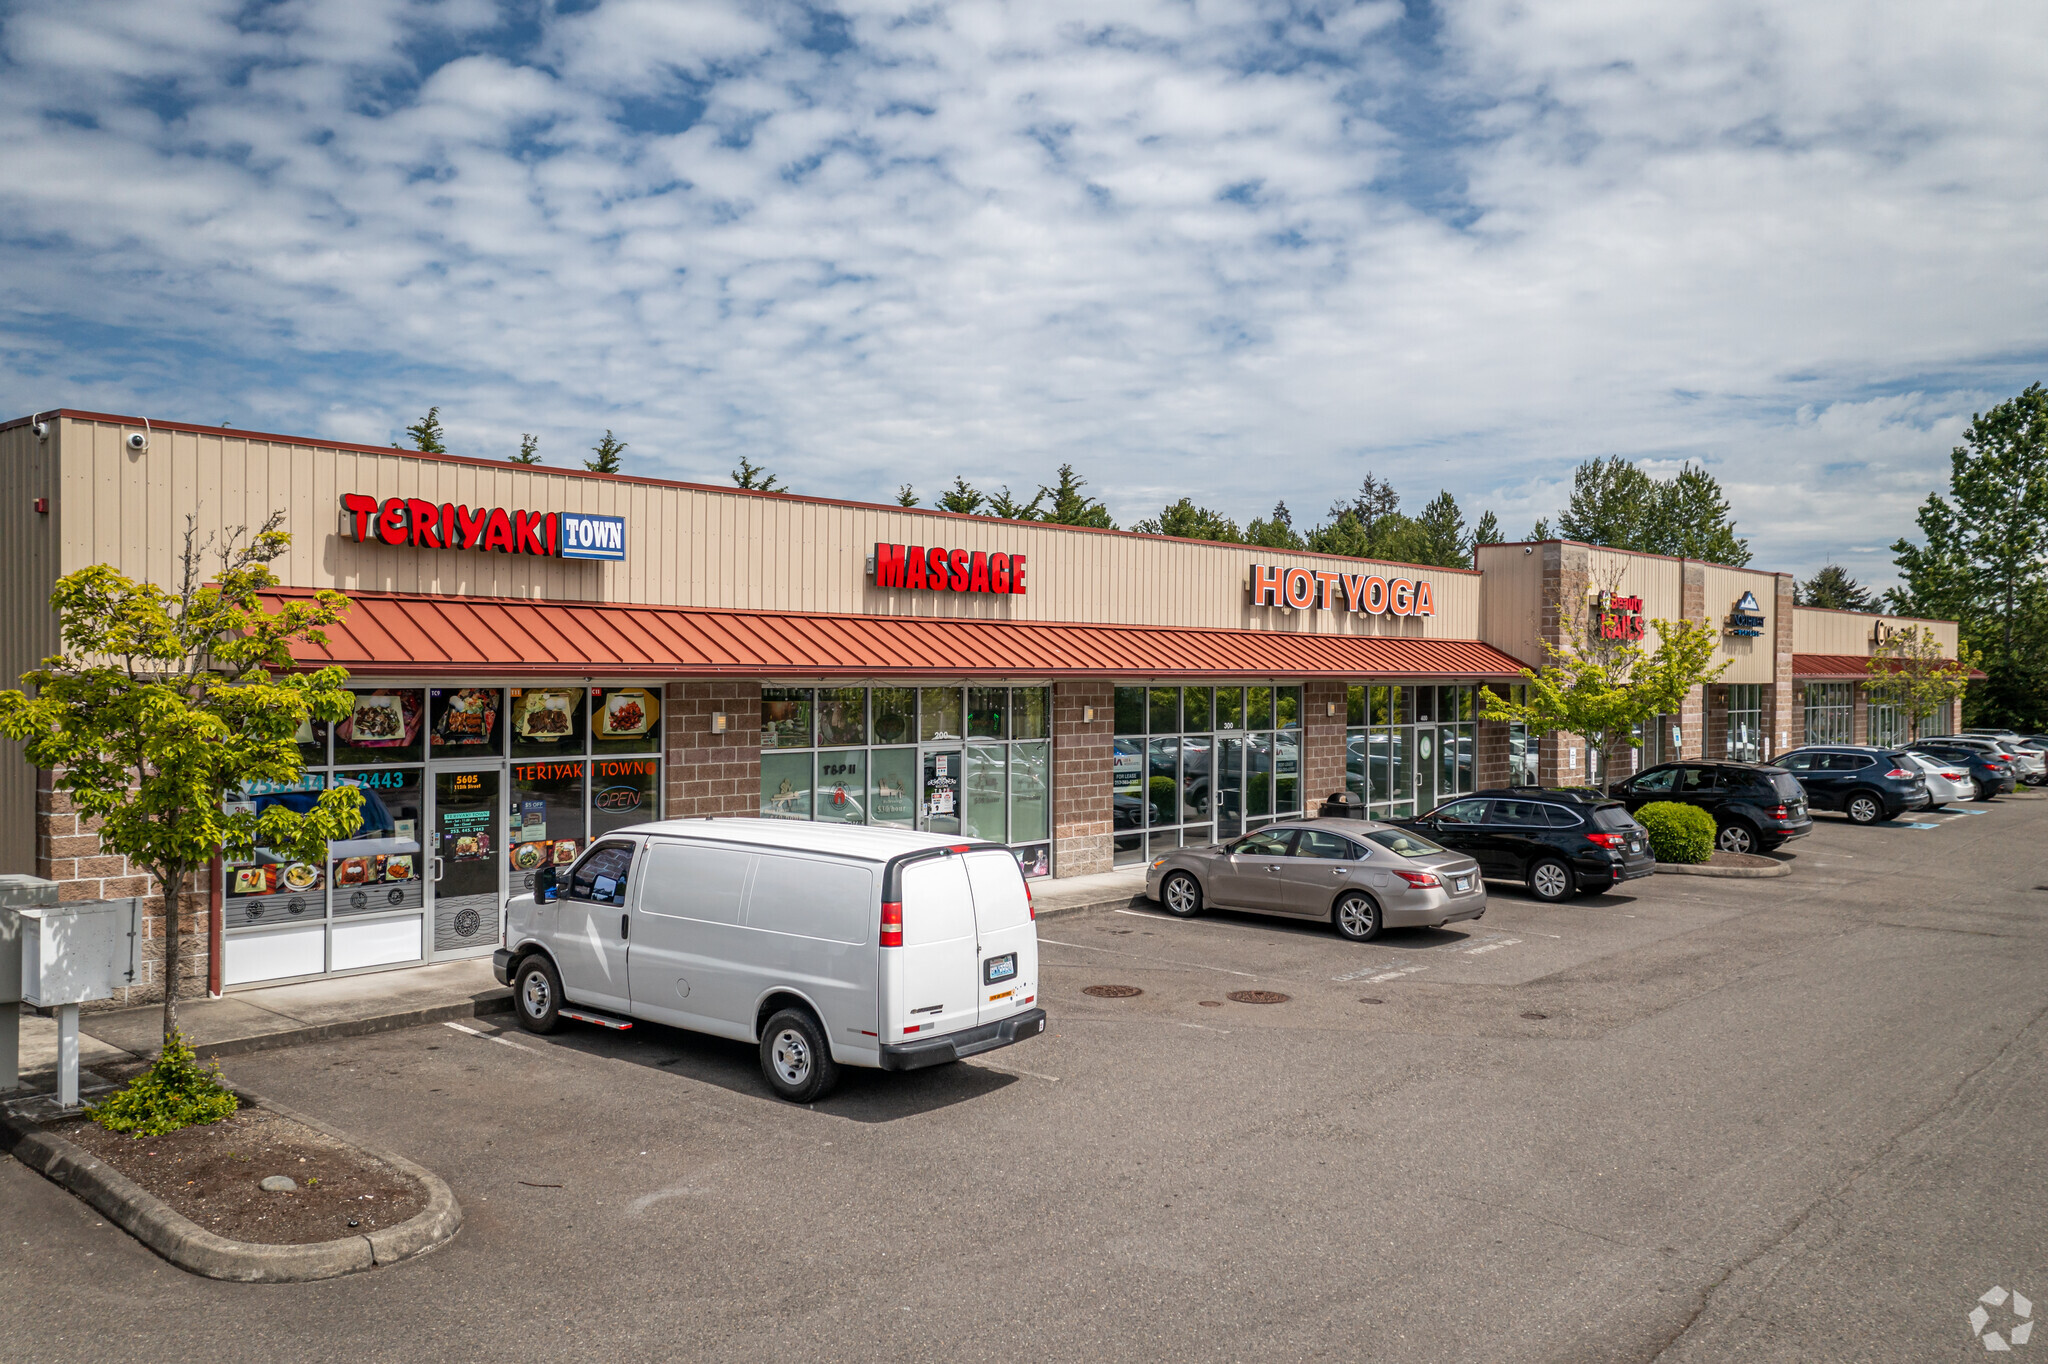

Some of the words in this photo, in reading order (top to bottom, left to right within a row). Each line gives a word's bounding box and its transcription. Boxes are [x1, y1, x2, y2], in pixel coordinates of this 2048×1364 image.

[341, 493, 557, 556] TERIYAKI
[566, 518, 622, 549] TOWN
[876, 542, 1026, 595] MASSAGE
[1252, 564, 1340, 610] HOT
[1341, 573, 1437, 617] YOGA
[1611, 592, 1643, 614] Beauty
[1600, 613, 1645, 641] NAILS
[934, 731, 949, 739] 200
[1223, 722, 1234, 730] 300
[456, 774, 478, 785] 5605
[516, 763, 595, 781] TERIYAKI
[600, 761, 645, 777] TOWN
[596, 791, 642, 807] OPEN
